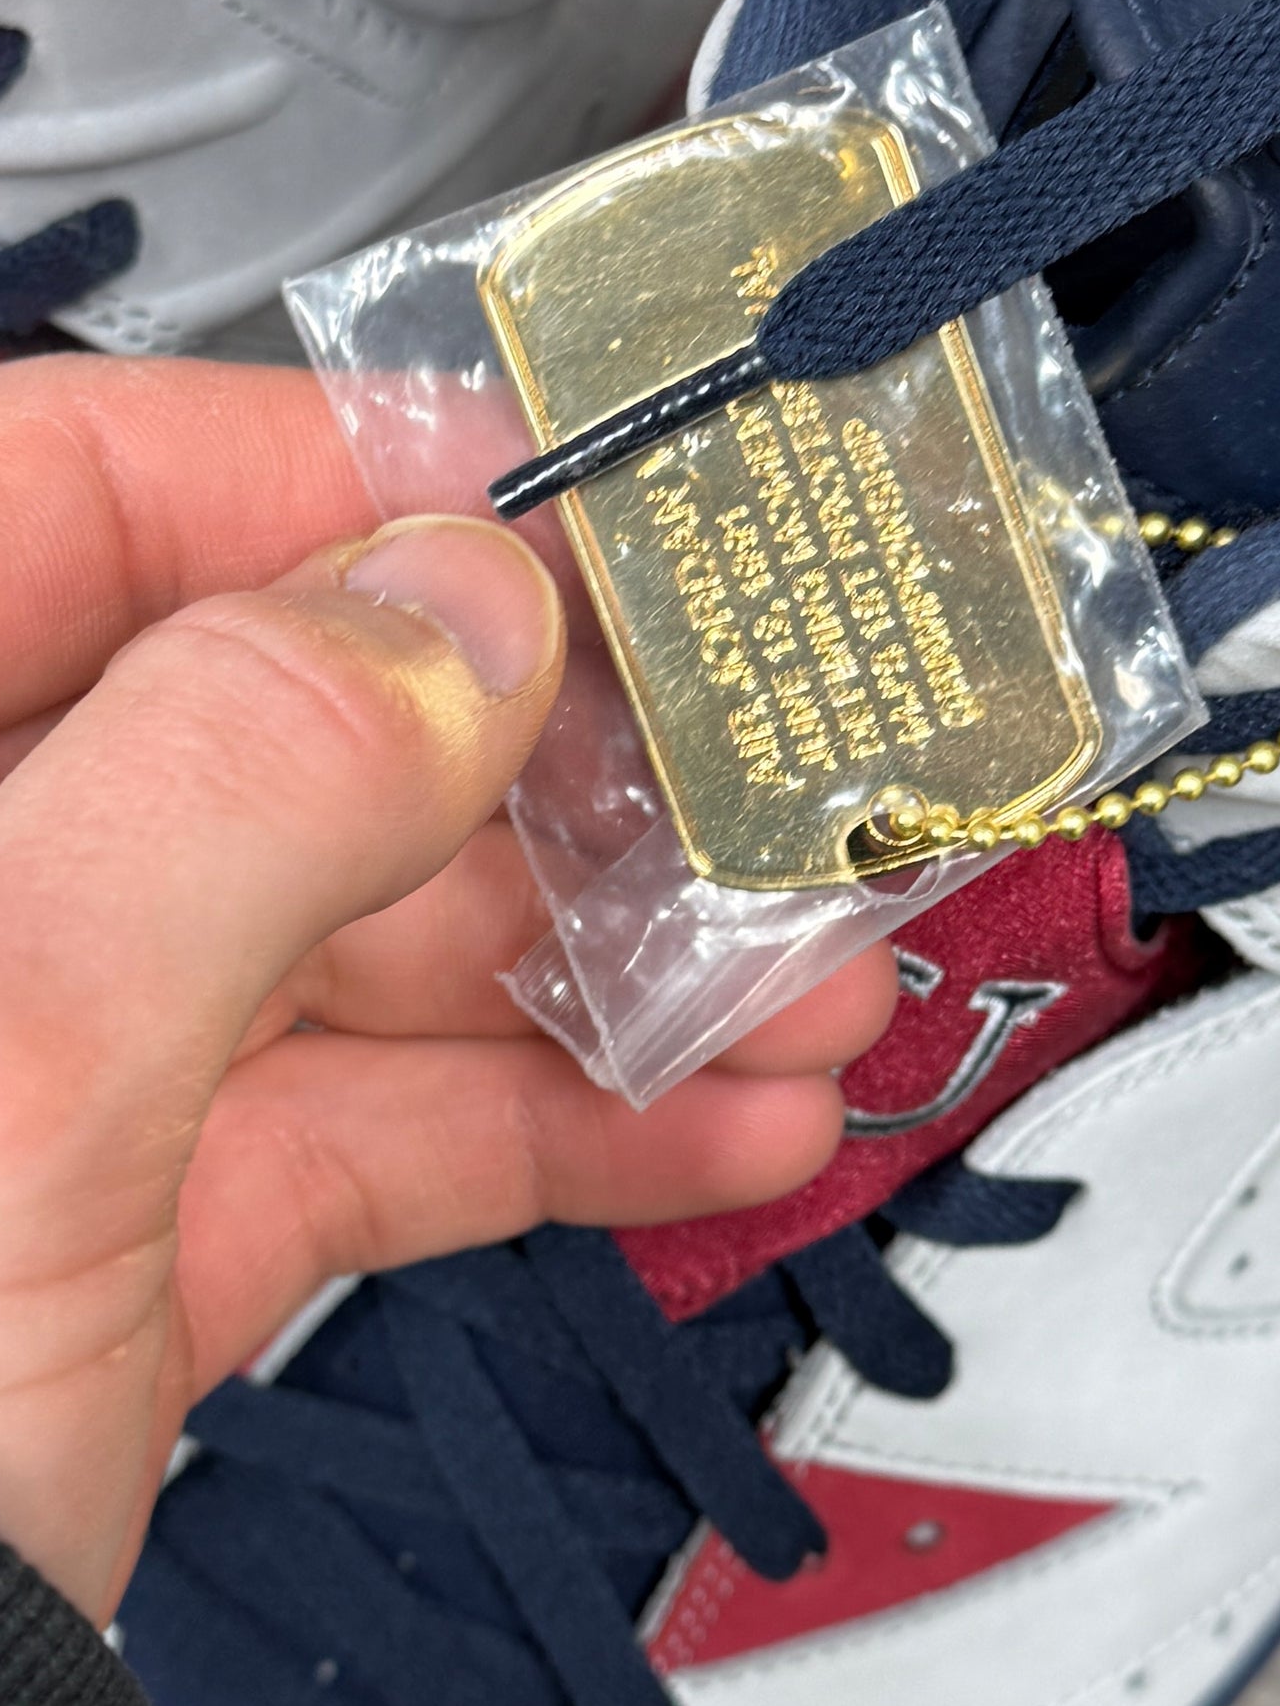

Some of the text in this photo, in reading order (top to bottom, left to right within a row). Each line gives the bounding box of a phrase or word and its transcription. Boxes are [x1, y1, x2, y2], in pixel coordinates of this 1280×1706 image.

[646, 483, 759, 693] JORDAN
[842, 417, 983, 727] CHAMPIONSHIP
[842, 566, 894, 641] 1ST
[770, 669, 838, 772] JUNE
[790, 570, 883, 760] DEFINING
[727, 699, 793, 787] AIR
